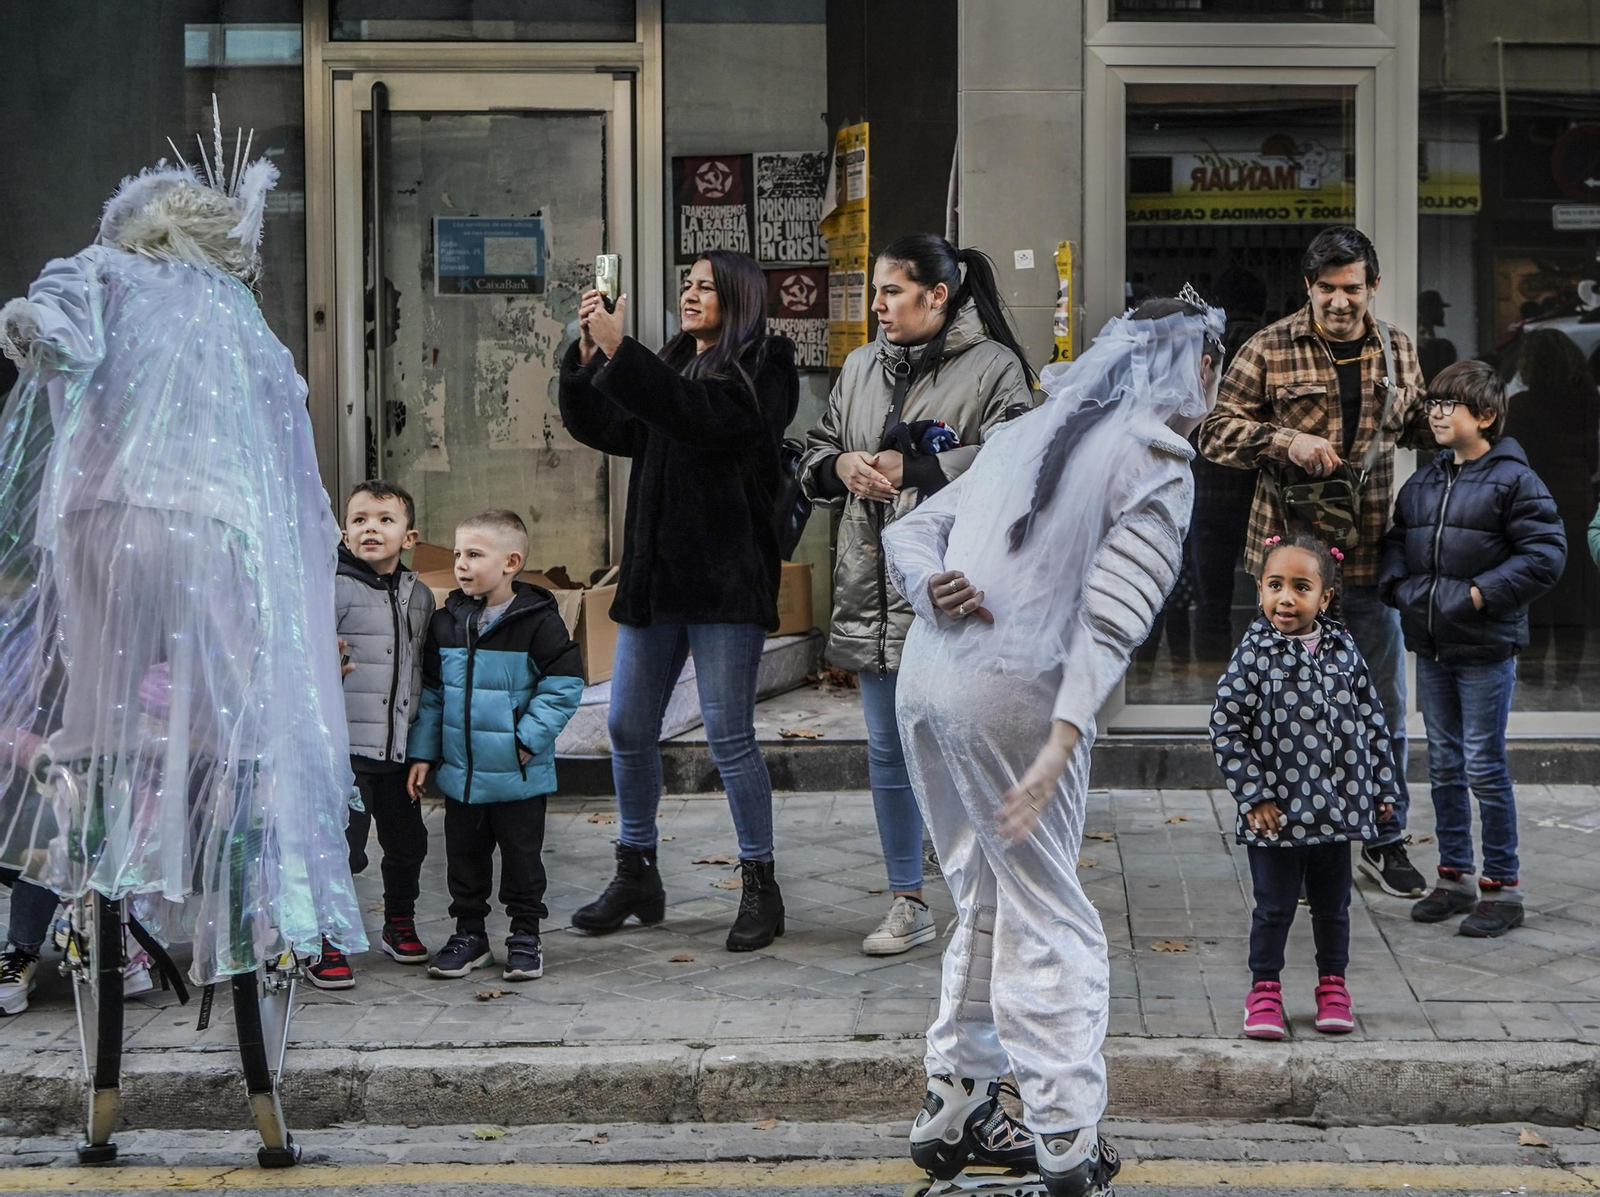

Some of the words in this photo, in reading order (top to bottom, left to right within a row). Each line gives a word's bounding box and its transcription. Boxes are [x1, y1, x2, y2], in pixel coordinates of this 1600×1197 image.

[681, 204, 747, 219] TRANSFORMEMOS
[759, 197, 826, 222] PRISIONERO
[681, 214, 699, 233] LA
[702, 214, 749, 233] RABIA
[760, 222, 783, 243] DE
[785, 221, 811, 239] UNA
[681, 231, 695, 255] EN
[696, 229, 751, 254] RESPUESTA
[761, 242, 776, 260] EN
[778, 236, 829, 260] CRISIS
[476, 278, 530, 290] CaixaBank
